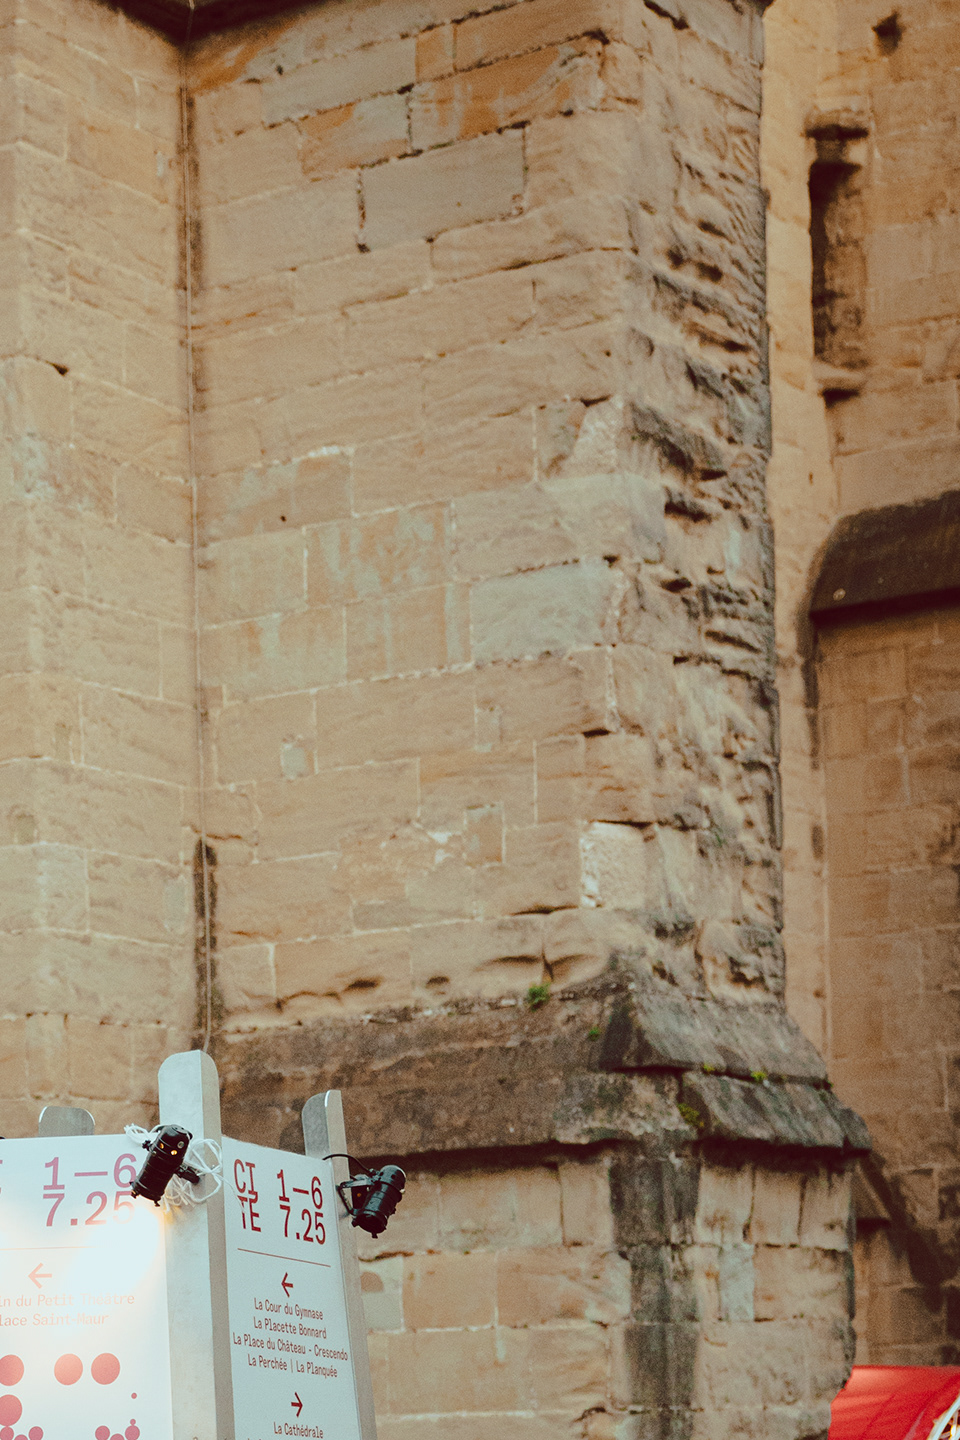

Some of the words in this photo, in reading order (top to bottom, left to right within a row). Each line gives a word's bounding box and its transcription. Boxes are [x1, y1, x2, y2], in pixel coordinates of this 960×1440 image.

[233, 1159, 256, 1195] CI
[43, 1190, 137, 1227] 7.25
[279, 1204, 326, 1245] 7.25
[15, 1294, 32, 1308] du
[37, 1294, 75, 1307] Petit
[254, 1297, 263, 1310] La
[265, 1299, 282, 1313] Cour
[284, 1303, 293, 1315] du
[295, 1304, 324, 1320] Gymnase
[253, 1316, 263, 1329] La
[264, 1318, 297, 1335] Placette
[299, 1323, 327, 1339] Bonnard
[233, 1332, 242, 1345] La
[244, 1334, 265, 1349] Place
[267, 1337, 275, 1350] du
[277, 1338, 306, 1354] Château
[314, 1344, 348, 1361] Crescendo
[247, 1353, 257, 1367] La
[258, 1355, 287, 1371] Perchée
[296, 1360, 305, 1373] La
[306, 1361, 338, 1379] Planquée
[274, 1421, 282, 1434] La
[284, 1422, 324, 1439] Cathédrale
